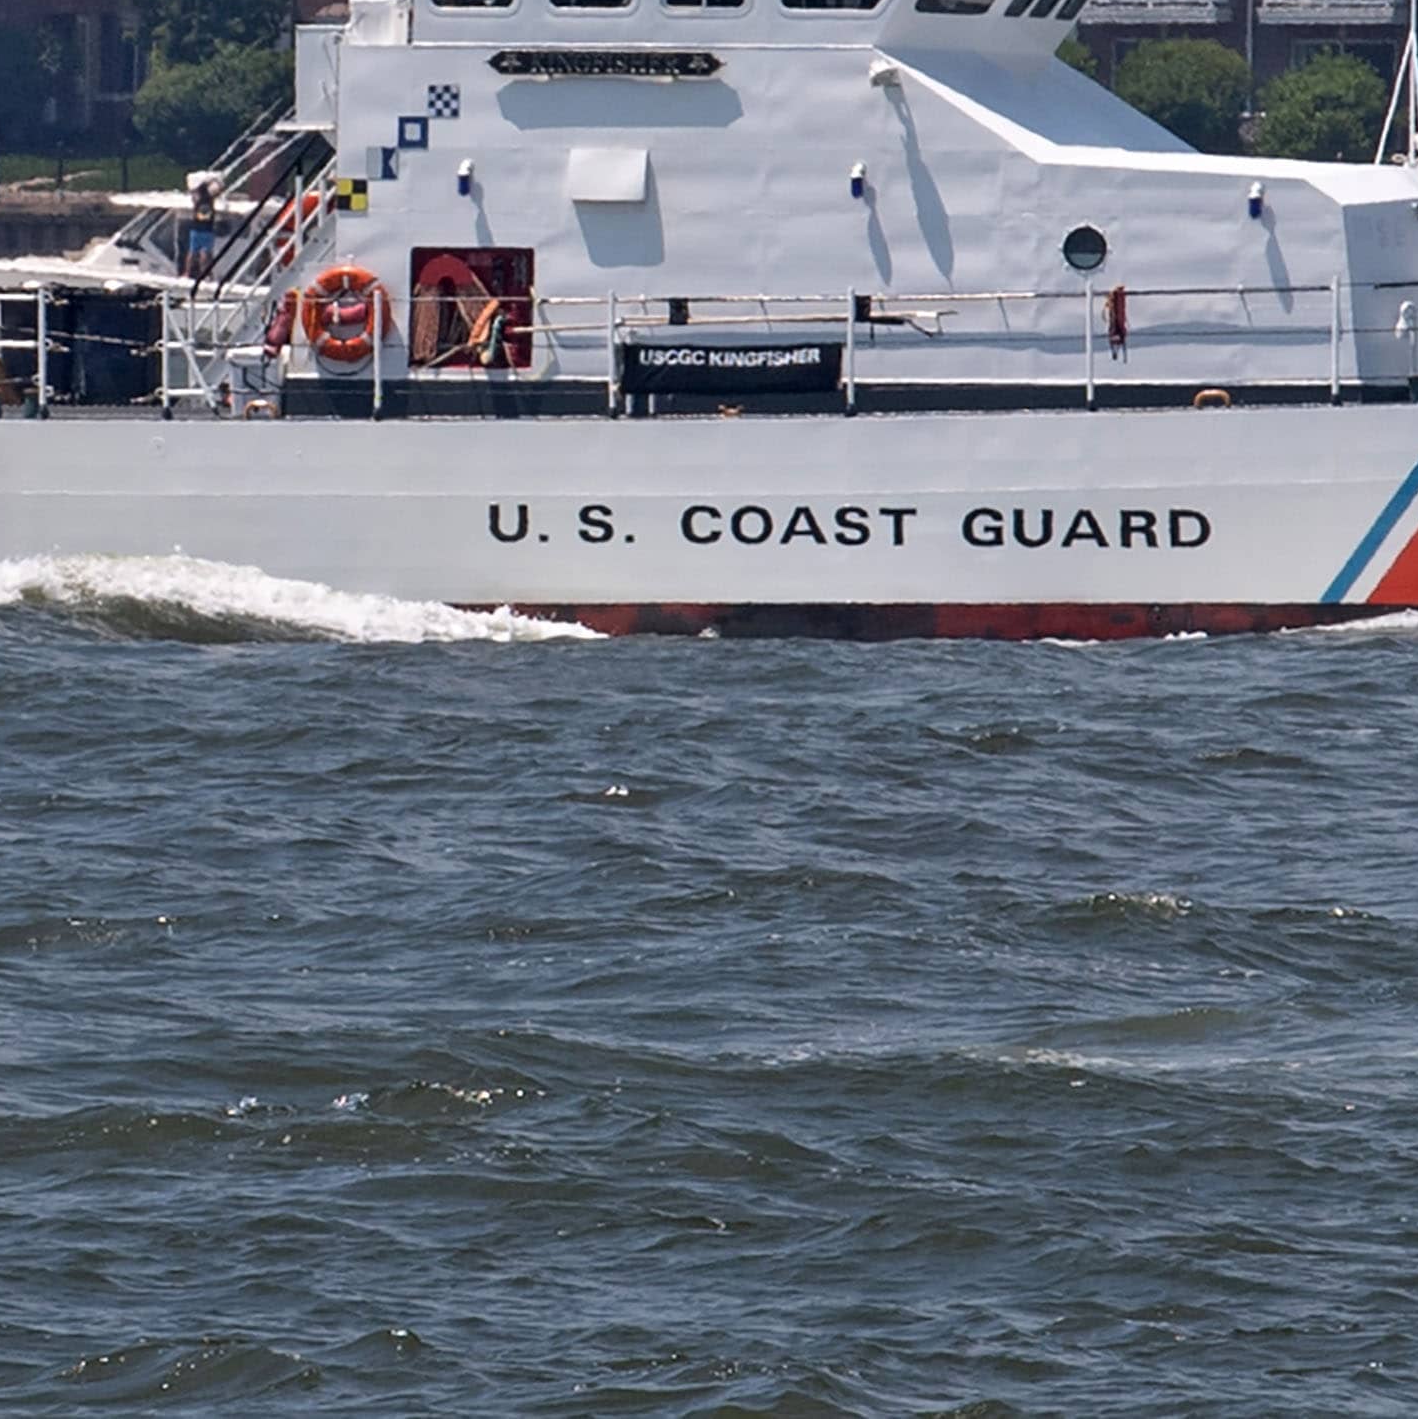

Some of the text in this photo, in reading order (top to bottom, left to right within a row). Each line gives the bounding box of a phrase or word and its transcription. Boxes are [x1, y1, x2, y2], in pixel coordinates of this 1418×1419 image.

[639, 348, 821, 367] USCGC KINGFISHER
[681, 505, 917, 546] COAST
[962, 507, 1211, 549] GUARD
